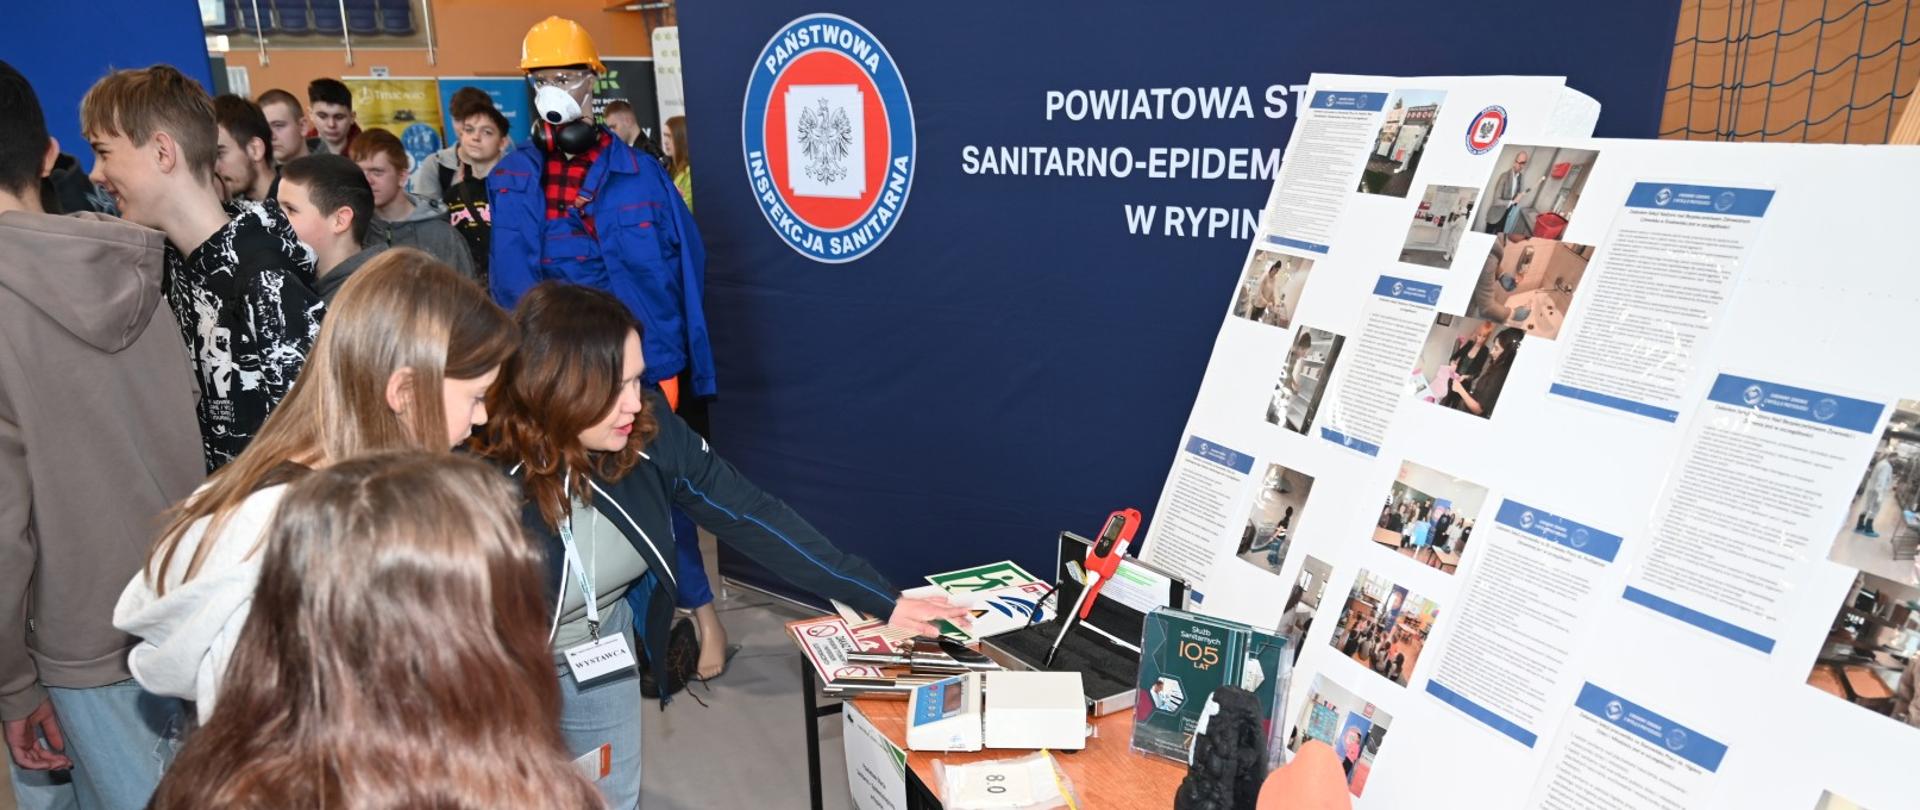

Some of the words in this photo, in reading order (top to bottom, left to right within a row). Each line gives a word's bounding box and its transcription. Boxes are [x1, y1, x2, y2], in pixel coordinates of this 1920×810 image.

[765, 24, 880, 76] PAŃSTWOWA
[1046, 86, 1254, 121] POWIATOWA
[750, 151, 825, 254] INSPEKCJA
[830, 155, 909, 255] SANITARNA
[1125, 205, 1156, 235] W
[575, 649, 627, 669] WYSTAWCA
[1179, 640, 1219, 665] 105
[1193, 661, 1209, 671] LAT
